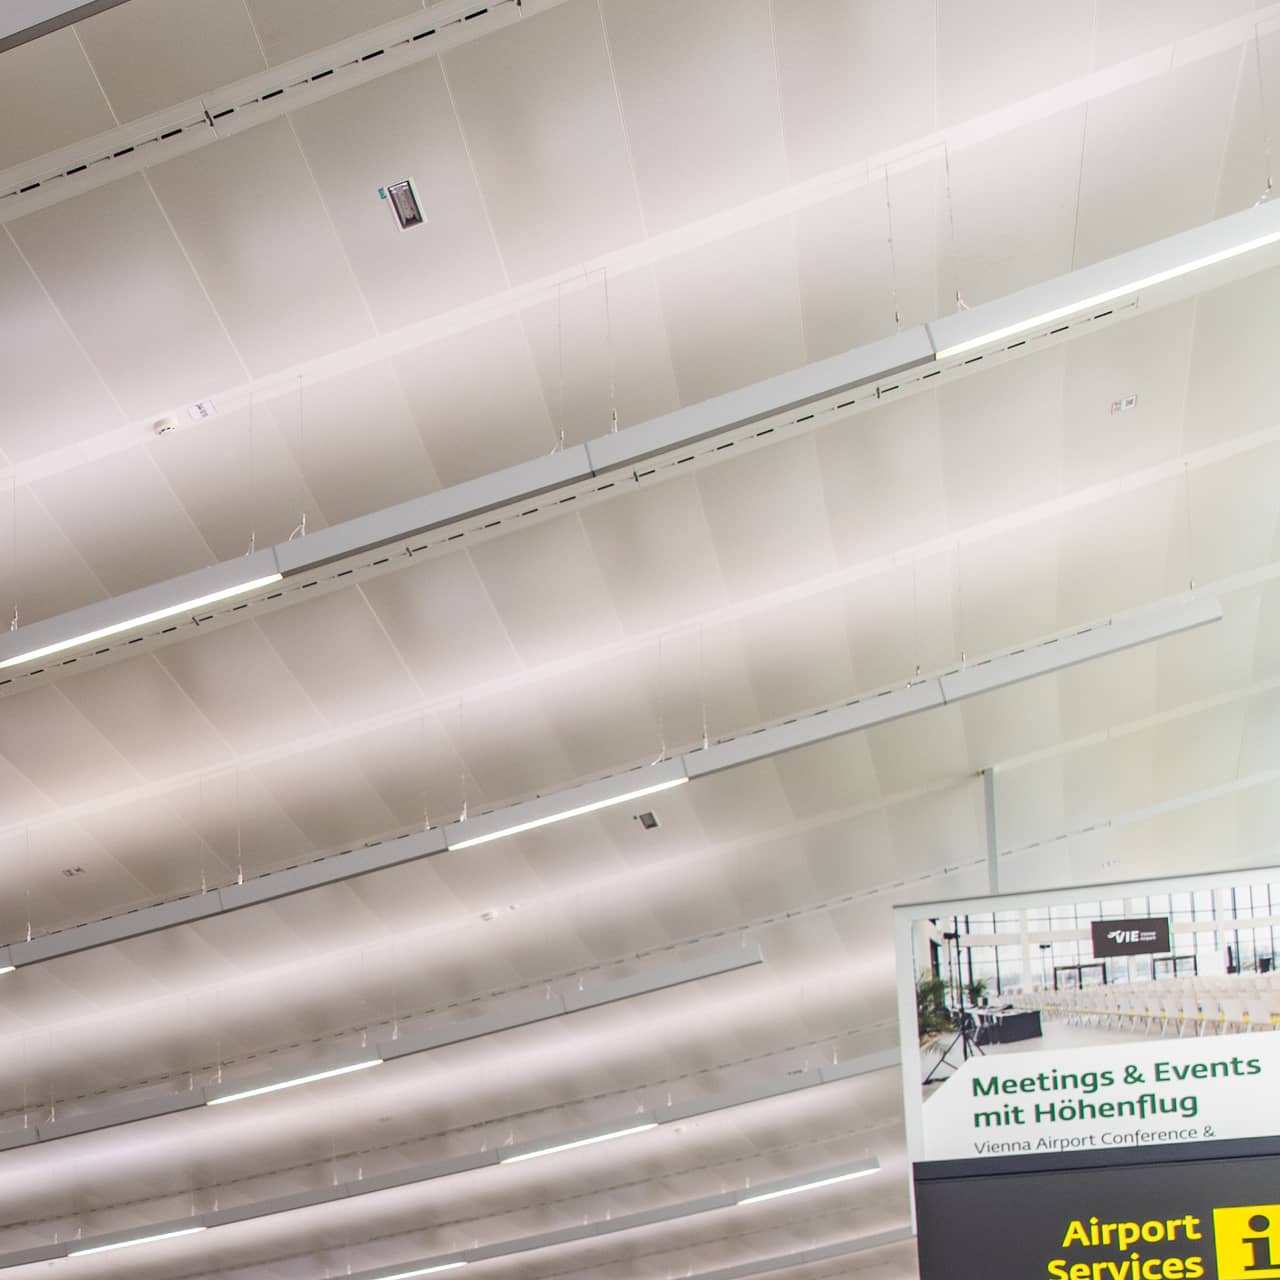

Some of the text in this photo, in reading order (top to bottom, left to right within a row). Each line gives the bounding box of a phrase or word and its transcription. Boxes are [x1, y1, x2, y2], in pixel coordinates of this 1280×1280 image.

[1115, 930, 1139, 943] VIE
[972, 1057, 1262, 1096] Meetings & Events
[974, 1094, 1198, 1128] mit Höhenflug
[974, 1125, 1216, 1154] Vienna Airport Conference &
[1062, 1215, 1202, 1251] Airport
